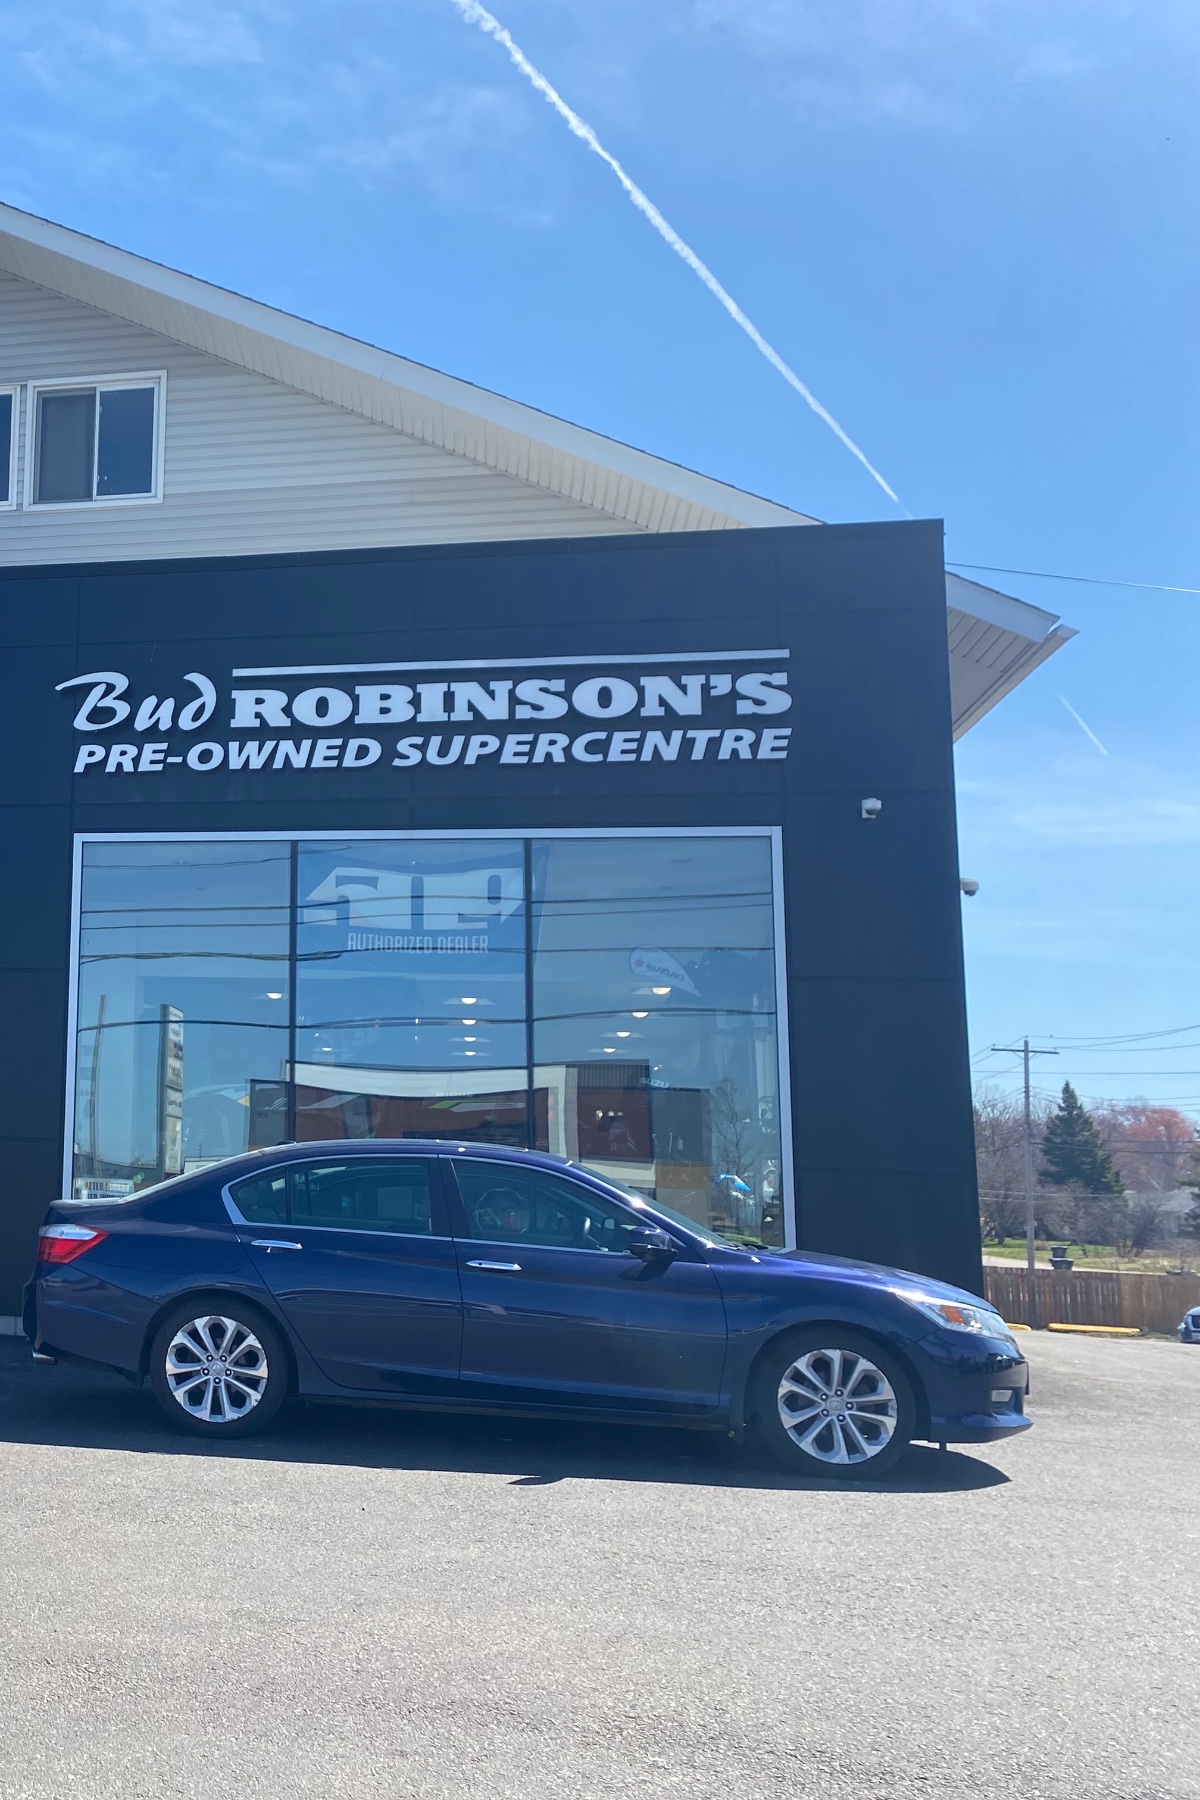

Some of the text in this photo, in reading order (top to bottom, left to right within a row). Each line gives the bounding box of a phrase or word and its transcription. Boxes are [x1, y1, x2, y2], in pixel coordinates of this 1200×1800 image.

[55, 671, 793, 734] Bud ROBINSON'S
[73, 726, 793, 773] PRE-OWNED SUPERCENTRE
[347, 932, 489, 954] AUTHORIZED DEALER
[645, 962, 685, 982] SUZUKI
